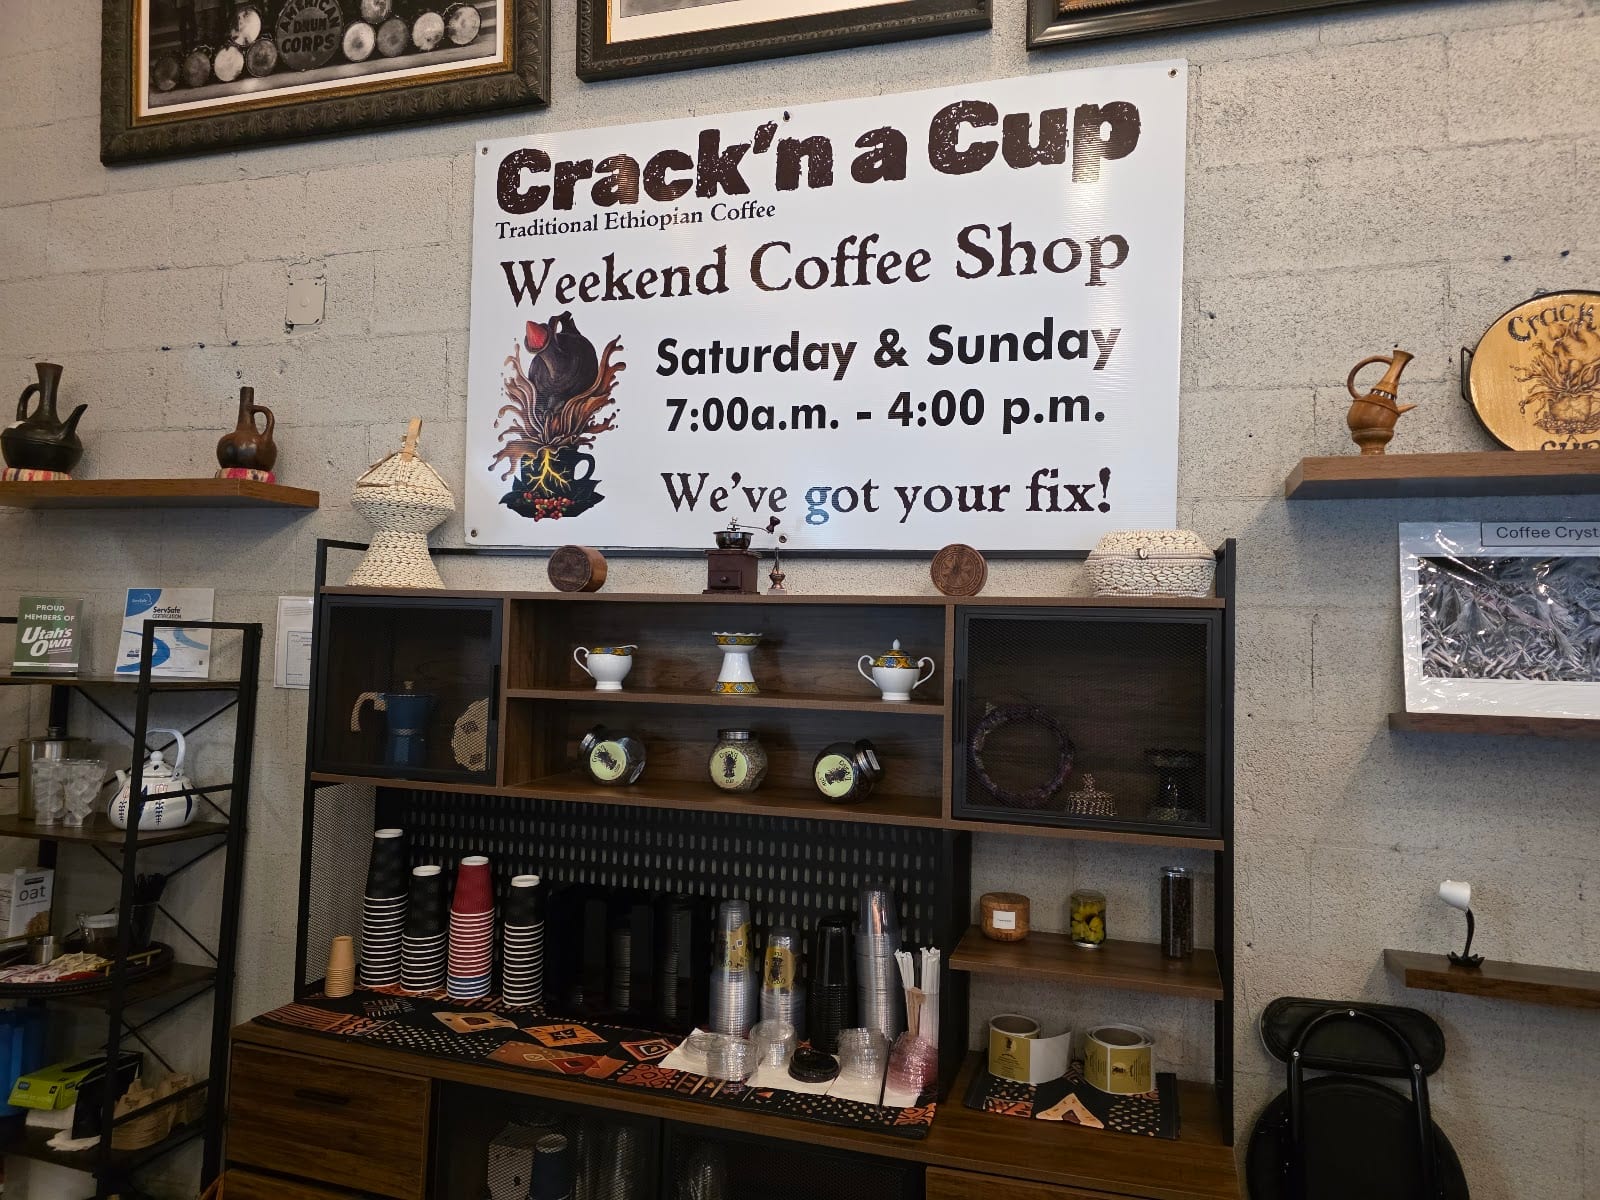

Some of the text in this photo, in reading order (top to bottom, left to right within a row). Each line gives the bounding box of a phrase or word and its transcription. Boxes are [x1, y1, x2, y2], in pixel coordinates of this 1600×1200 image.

[293, 18, 327, 33] DRUM
[281, 33, 336, 53] CORPS
[496, 98, 1141, 214] Crack'n a Cup
[496, 199, 776, 240] Traditional Ethiopian Coffee
[500, 222, 1130, 308] Weekend Coffee Shop
[656, 317, 1121, 382] Saturday & Sunday
[666, 389, 1105, 434] 7:00a.m. - 4:00 p.m.
[661, 466, 1111, 526] We've got your fix!
[1496, 526, 1600, 540] Coffee Cryst
[24, 613, 61, 621] MEMBERS
[36, 604, 65, 612] PROUD
[21, 626, 72, 644] Utah's
[30, 639, 72, 657] Own
[19, 885, 46, 901] oat
